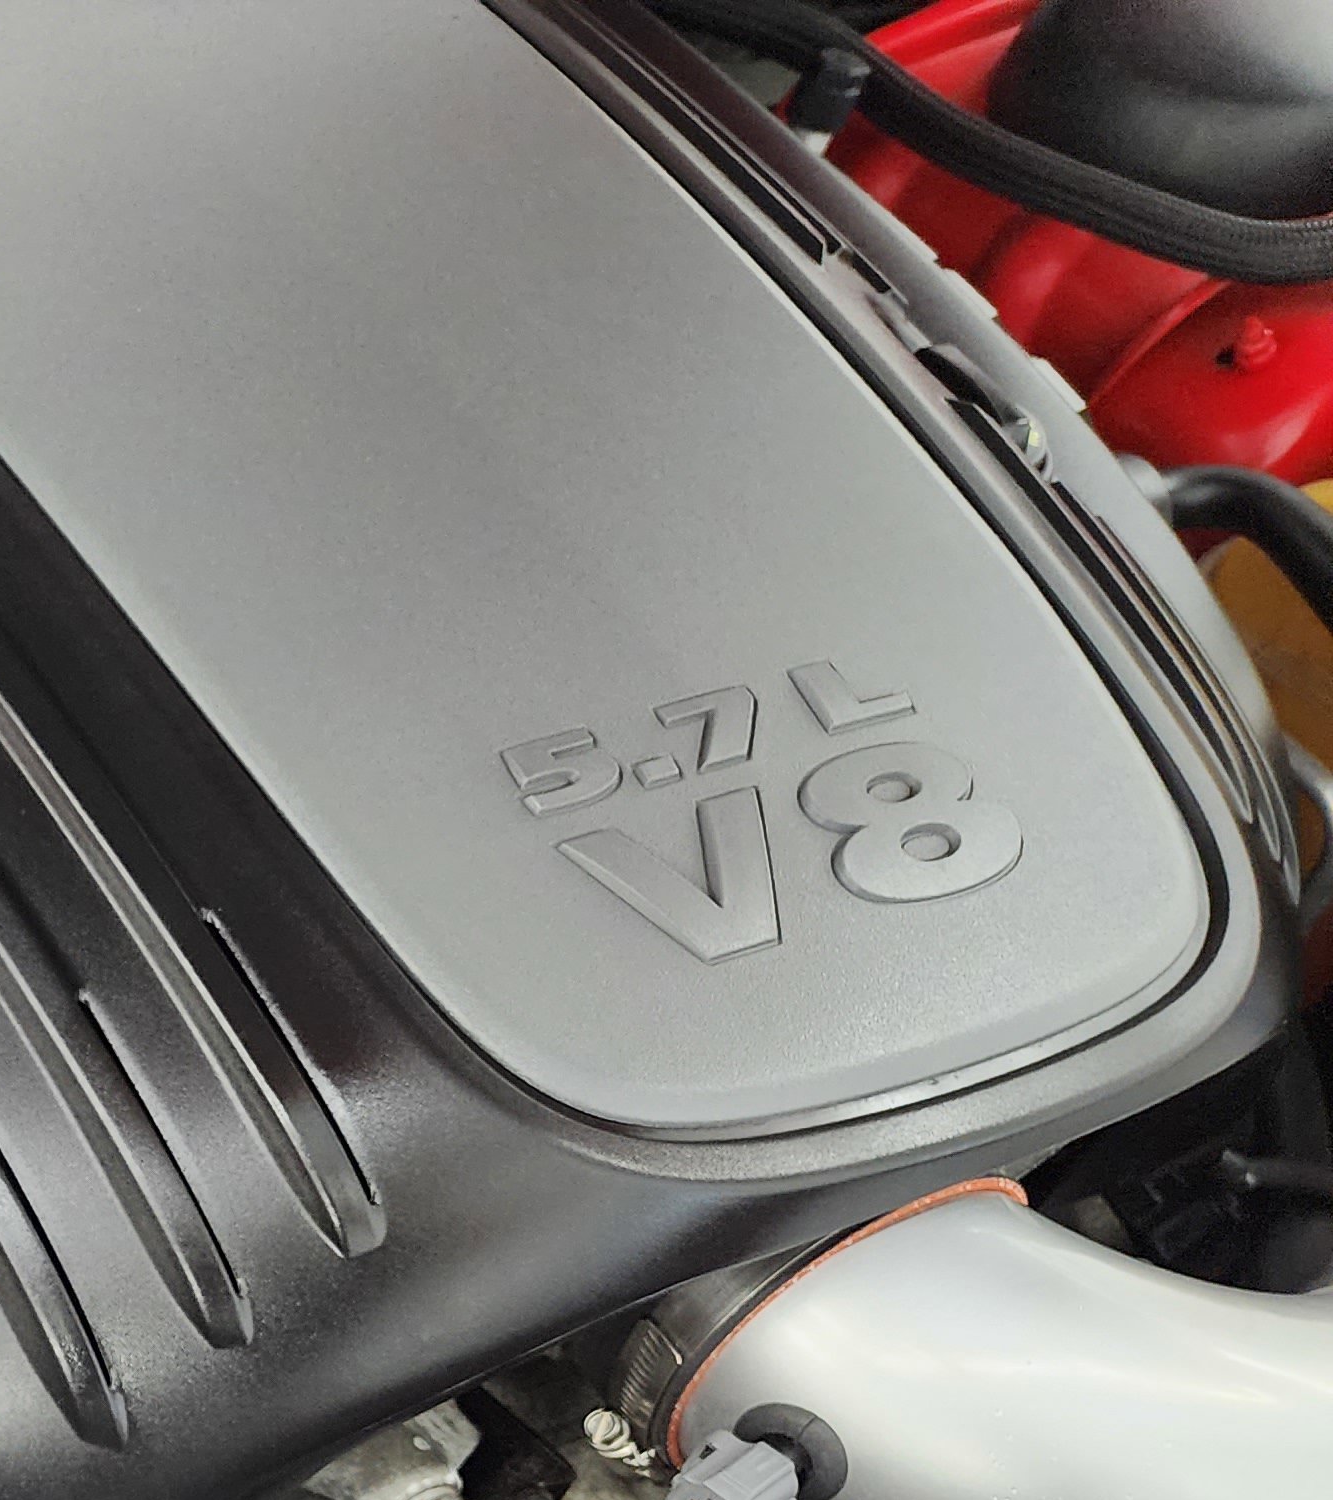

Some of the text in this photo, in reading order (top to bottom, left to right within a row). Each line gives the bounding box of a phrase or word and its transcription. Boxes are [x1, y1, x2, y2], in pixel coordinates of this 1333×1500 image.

[500, 660, 917, 816] 5.7 L
[554, 741, 1024, 965] V8
